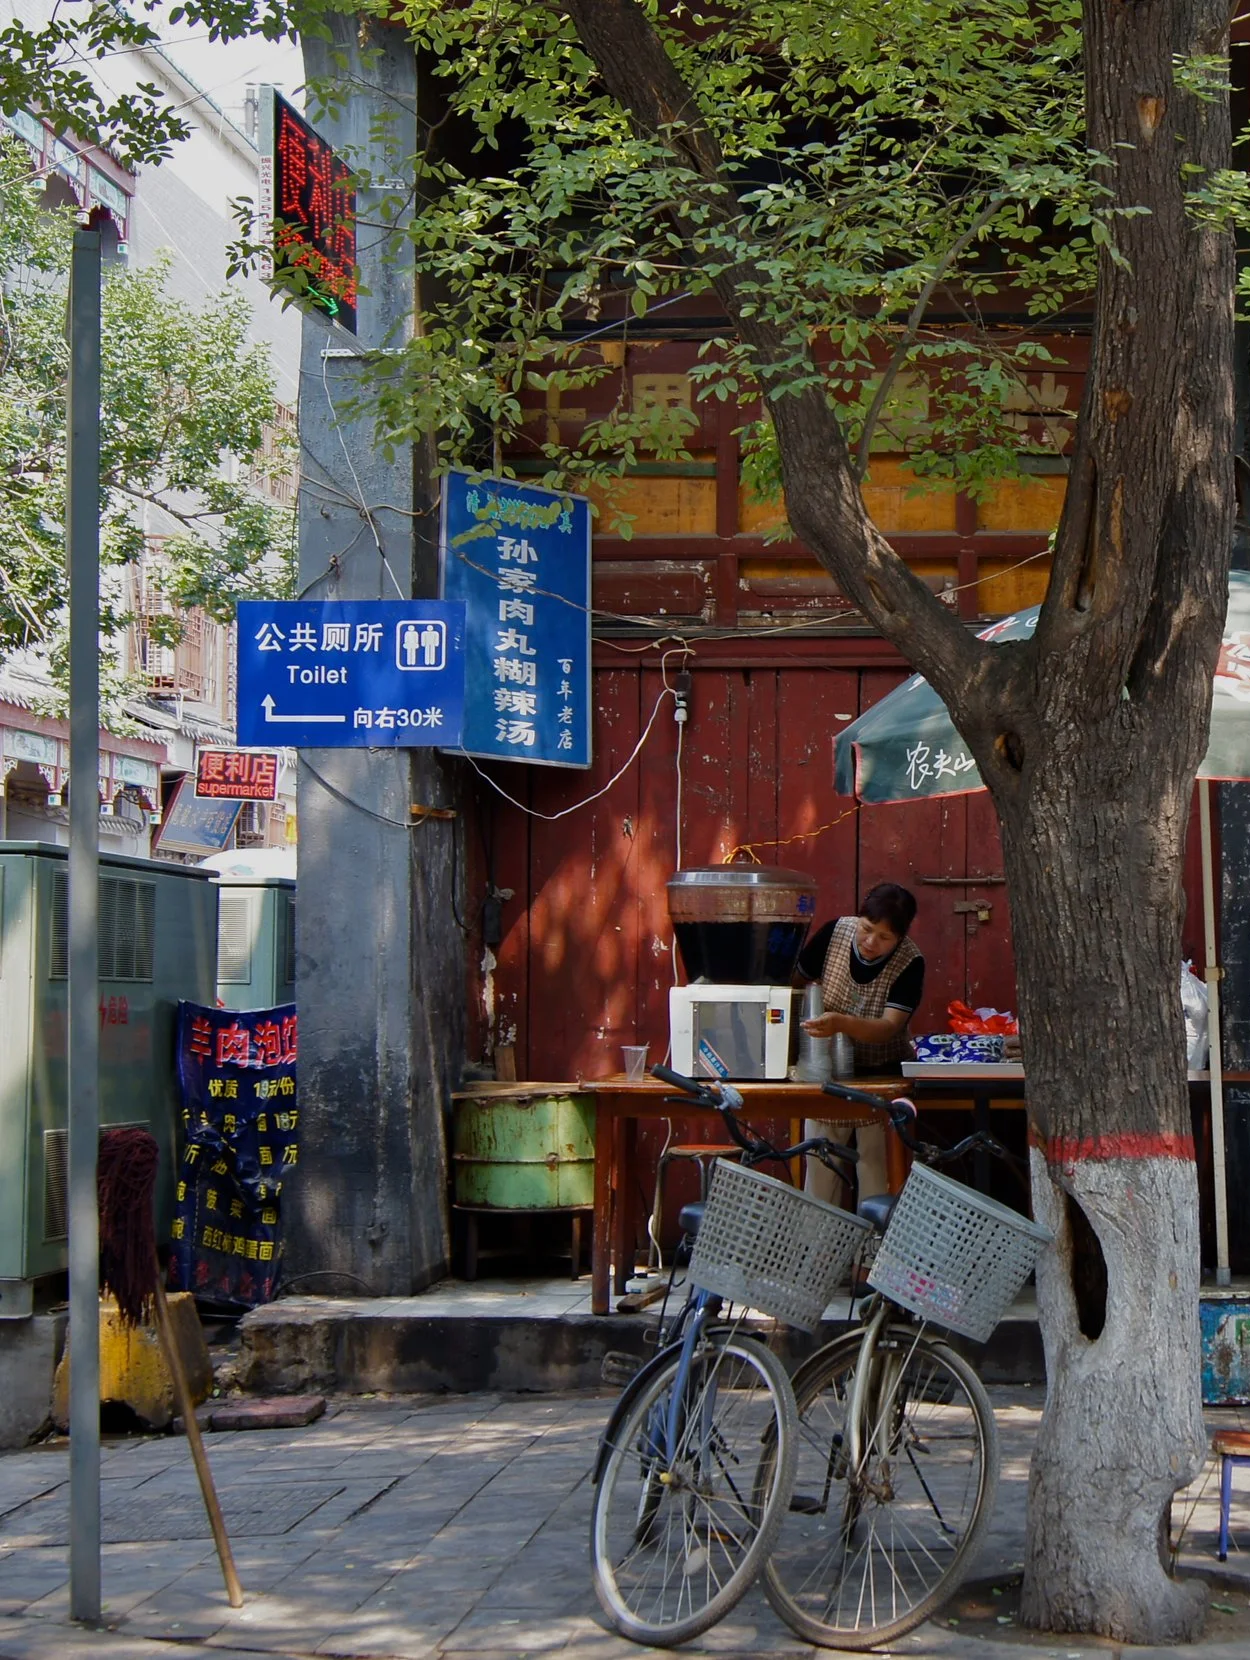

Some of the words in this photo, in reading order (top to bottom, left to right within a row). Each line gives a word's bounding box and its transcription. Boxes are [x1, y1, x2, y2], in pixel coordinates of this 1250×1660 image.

[255, 622, 384, 653] 公共厕所
[493, 535, 539, 747] 孙家肉丸糊辣汤
[287, 665, 348, 685] Toilet
[353, 706, 443, 728] 向右30米
[557, 658, 574, 750] 百年老店
[200, 752, 276, 784] 便利店
[198, 782, 275, 797] supermarket
[208, 1079, 239, 1099] 优质
